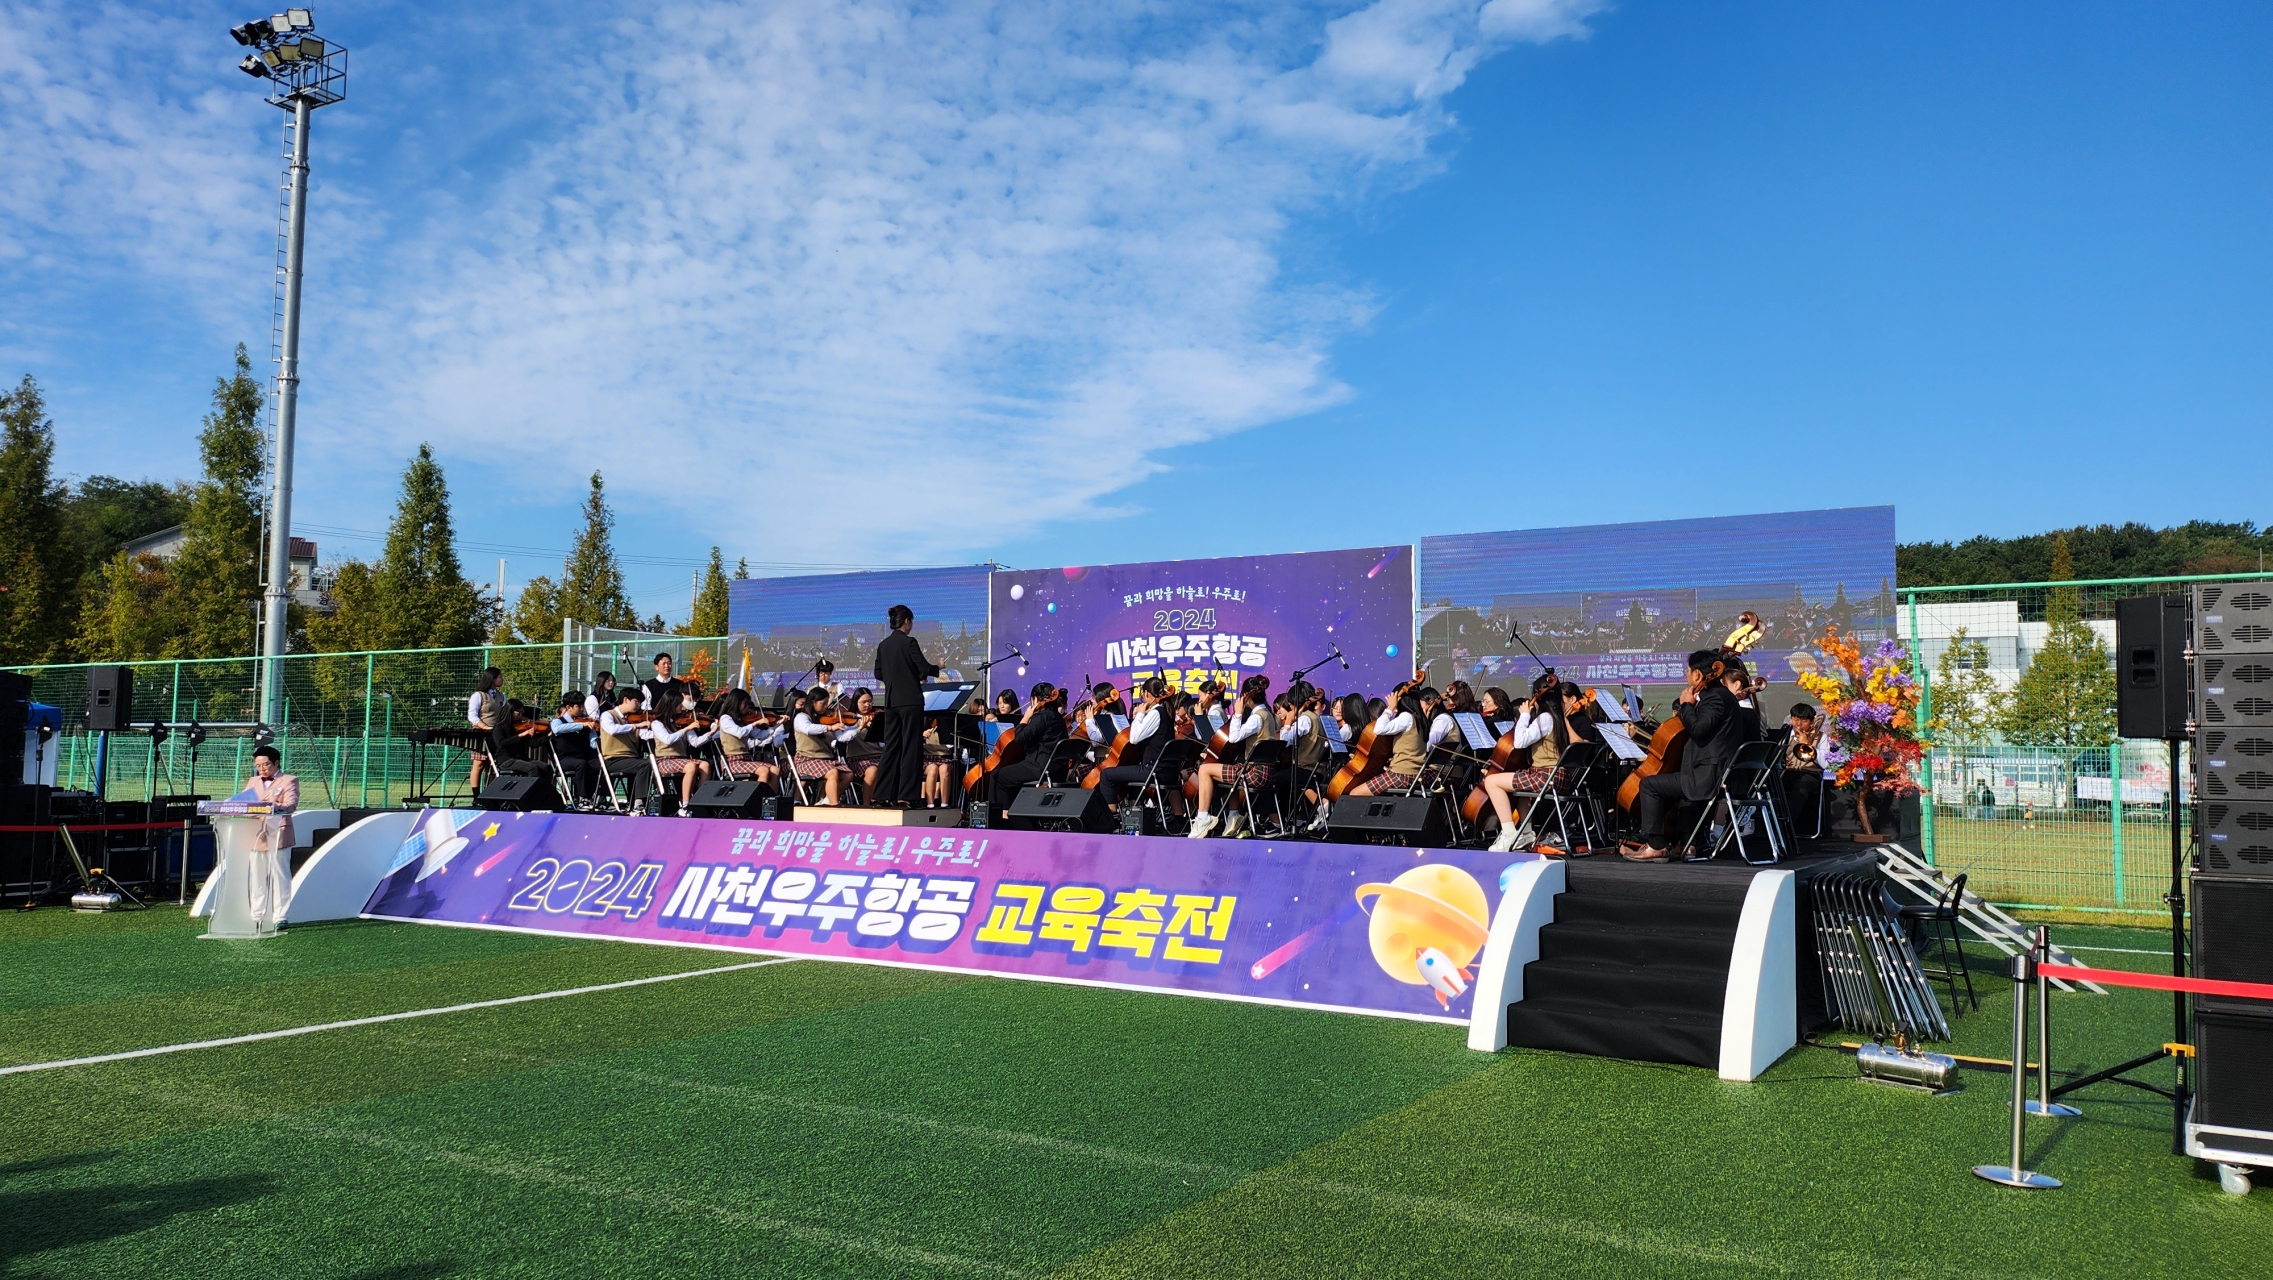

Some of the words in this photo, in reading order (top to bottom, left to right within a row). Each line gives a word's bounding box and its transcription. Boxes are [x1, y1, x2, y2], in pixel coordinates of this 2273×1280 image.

[1124, 592, 1143, 607] 꿈과
[1146, 586, 1174, 602] 희망을
[1176, 585, 1210, 602] 하늘로!
[1212, 586, 1247, 603] 우주로!
[1153, 608, 1217, 632] 2024
[1106, 633, 1267, 669] 사천우주항공
[1527, 665, 1581, 683] 224
[731, 828, 773, 856] 꿈과
[773, 830, 833, 863] 희망을
[837, 833, 910, 866] 하늘로!
[911, 836, 989, 868] 우주로!
[509, 857, 663, 918] 2024
[662, 866, 976, 941] 사천우주항공
[975, 884, 1237, 964] 교육축전
